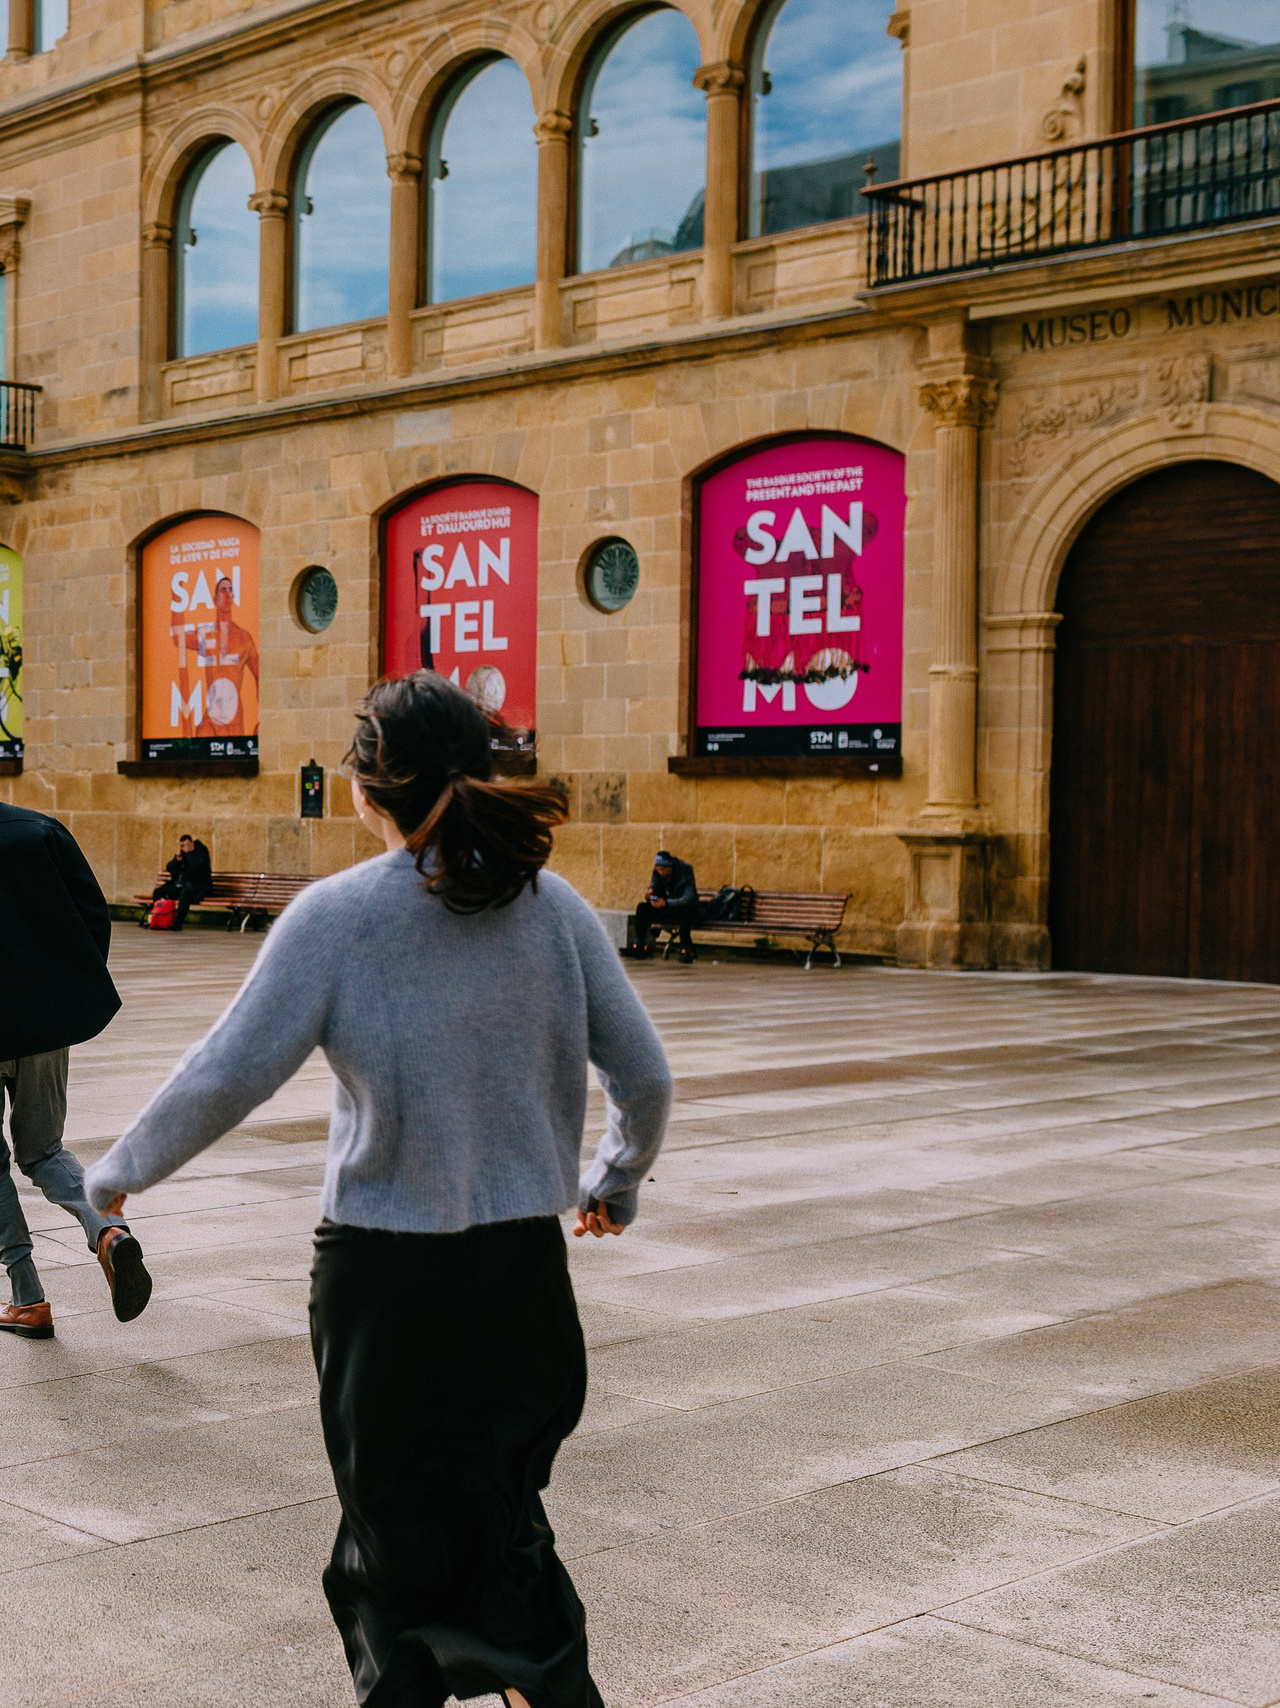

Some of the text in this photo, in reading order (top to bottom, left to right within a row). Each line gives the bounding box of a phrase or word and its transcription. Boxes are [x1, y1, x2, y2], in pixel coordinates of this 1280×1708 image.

[1021, 282, 1280, 351] MUSEO MUNIC
[745, 478, 863, 502] PRESENT AND THE PAST
[797, 469, 832, 483] SOCIETY
[833, 468, 845, 479] OF
[846, 466, 863, 478] THE
[421, 524, 433, 537] ET
[743, 501, 864, 565] SAN
[182, 551, 202, 563] AYER
[420, 537, 511, 591] SAN
[170, 565, 241, 613] SAN
[743, 572, 861, 637] TEL
[170, 621, 240, 669] TEL
[420, 600, 508, 654] TEL
[169, 677, 239, 728] MO
[447, 665, 506, 713] O
[742, 647, 859, 713] MO
[810, 731, 833, 743] STM
